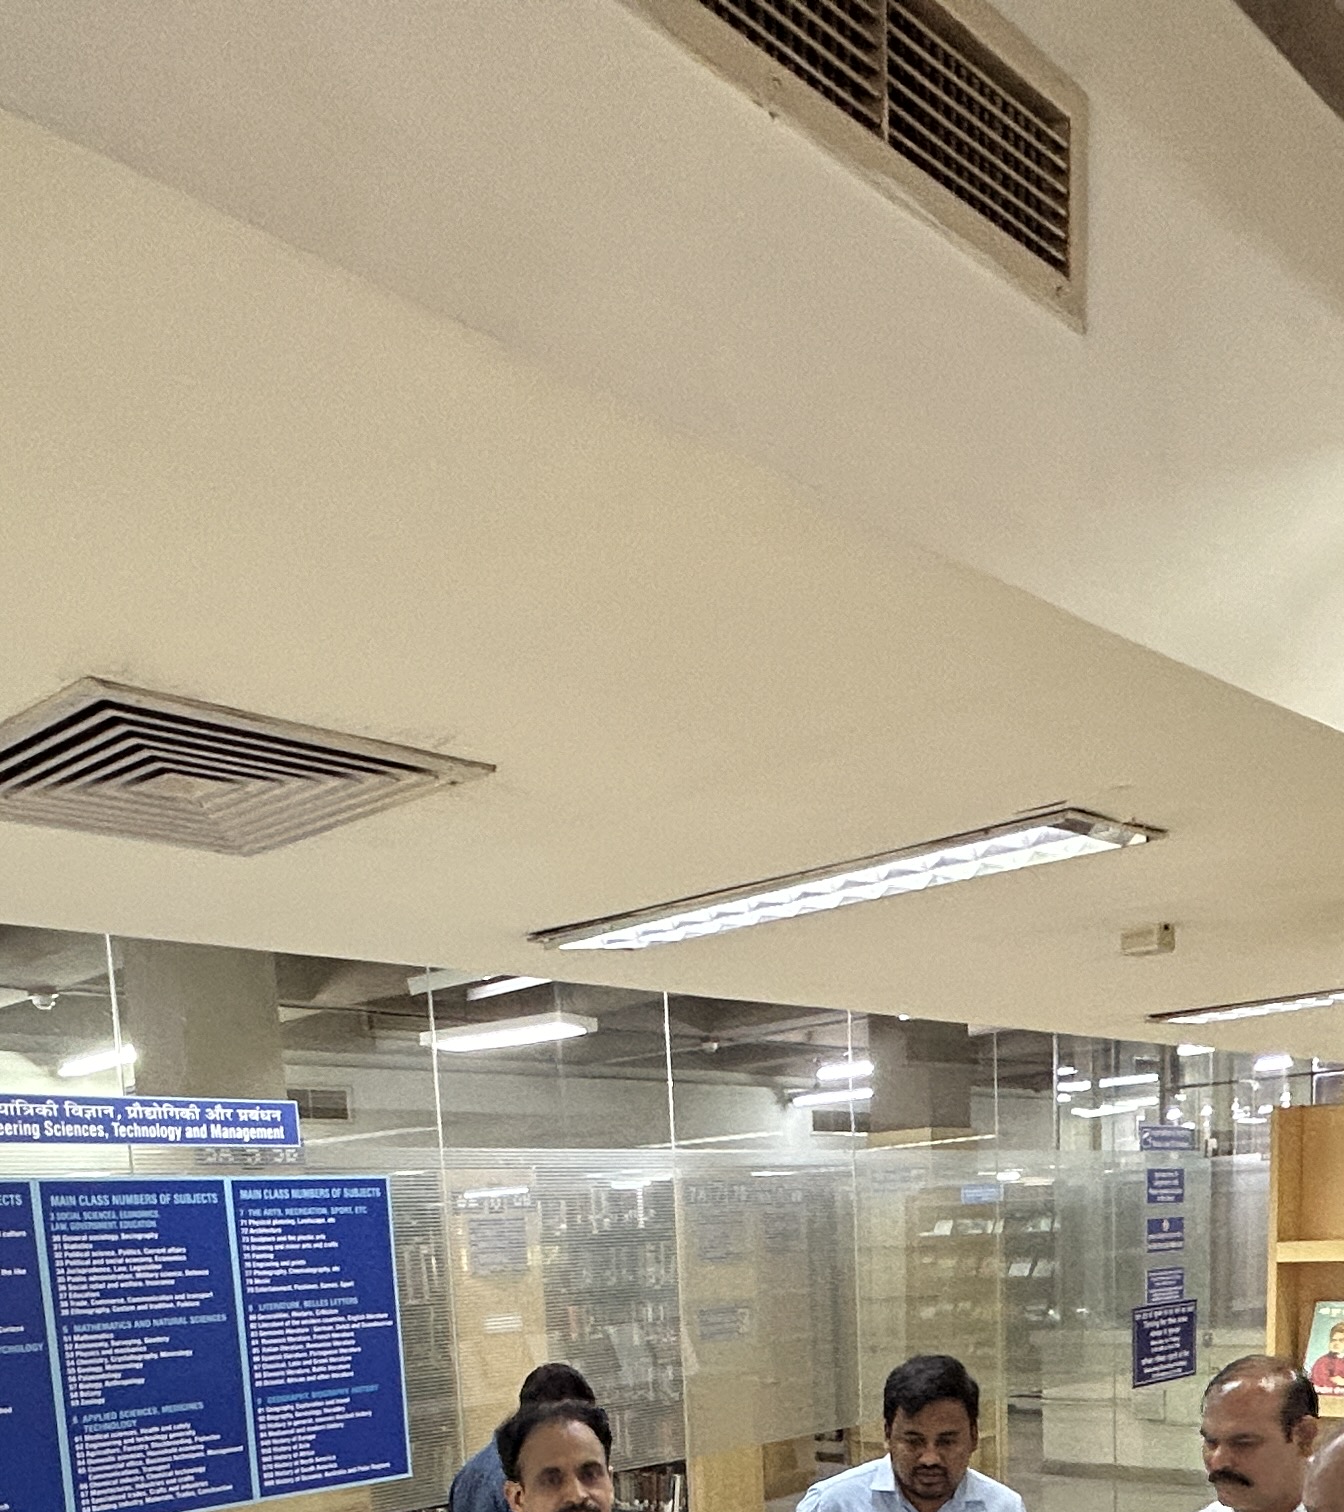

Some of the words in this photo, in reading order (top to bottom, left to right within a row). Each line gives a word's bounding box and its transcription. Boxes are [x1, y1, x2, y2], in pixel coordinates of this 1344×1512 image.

[125, 1101, 201, 1122] प्रौद्योगिकी
[204, 1103, 234, 1121] और
[237, 1105, 283, 1122] प्रबंधन
[43, 1121, 109, 1140] Sciences,
[112, 1122, 182, 1142] Technology
[184, 1124, 207, 1139] and
[210, 1124, 285, 1142] Management
[50, 1194, 76, 1206] MAIN
[78, 1194, 109, 1205] CLASS
[111, 1193, 157, 1205] NUMBERS
[159, 1193, 171, 1204] OF
[173, 1193, 218, 1204] SUBJECTS
[239, 1189, 261, 1199] MAIN
[263, 1188, 289, 1199] CLASS
[291, 1188, 330, 1198] NUMBERS
[331, 1188, 341, 1198] OF
[343, 1187, 381, 1198] SUBJECTS
[73, 1320, 132, 1332] MATHEMATICS
[133, 1319, 151, 1328] AND
